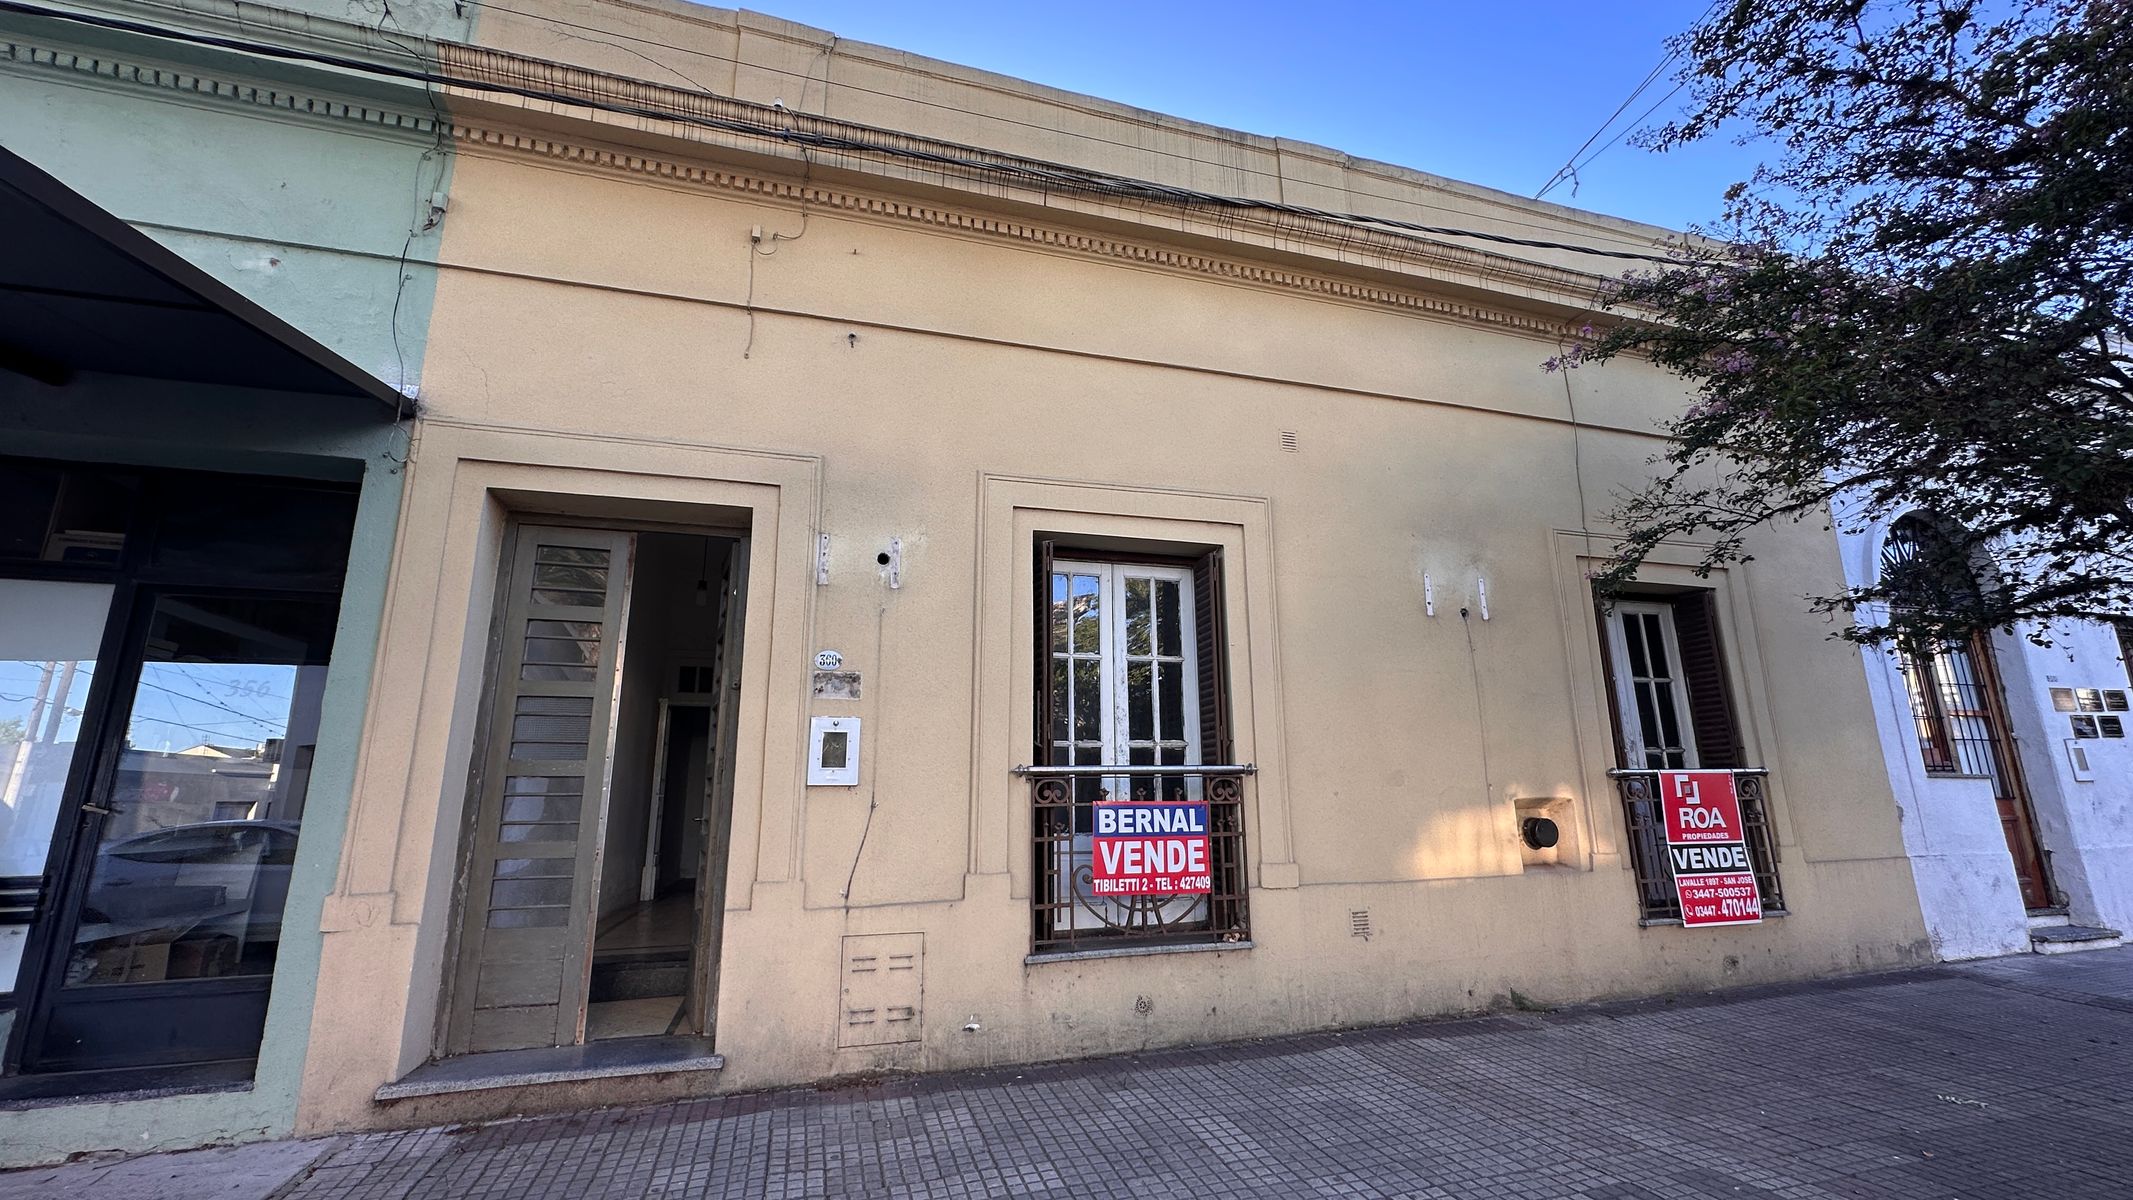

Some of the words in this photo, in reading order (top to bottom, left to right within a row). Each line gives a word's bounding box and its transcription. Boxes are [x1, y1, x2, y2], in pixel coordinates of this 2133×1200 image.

[819, 654, 837, 666] 360
[224, 679, 271, 697] 356
[1098, 808, 1204, 833] BERNAL
[1678, 807, 1727, 828] ROA
[1682, 832, 1729, 840] PROPIEDADES
[1099, 840, 1206, 874] VENDE
[1672, 847, 1747, 869] VENDE
[1093, 878, 1139, 892] TIBILETTI
[1142, 878, 1148, 891] 2
[1179, 876, 1211, 889] 427409
[1678, 878, 1705, 887] LAVALLE
[1724, 877, 1736, 885] SAN
[1692, 886, 1751, 899] 3447-500537
[1695, 905, 1716, 917] 03447
[1721, 898, 1759, 917] 470144
